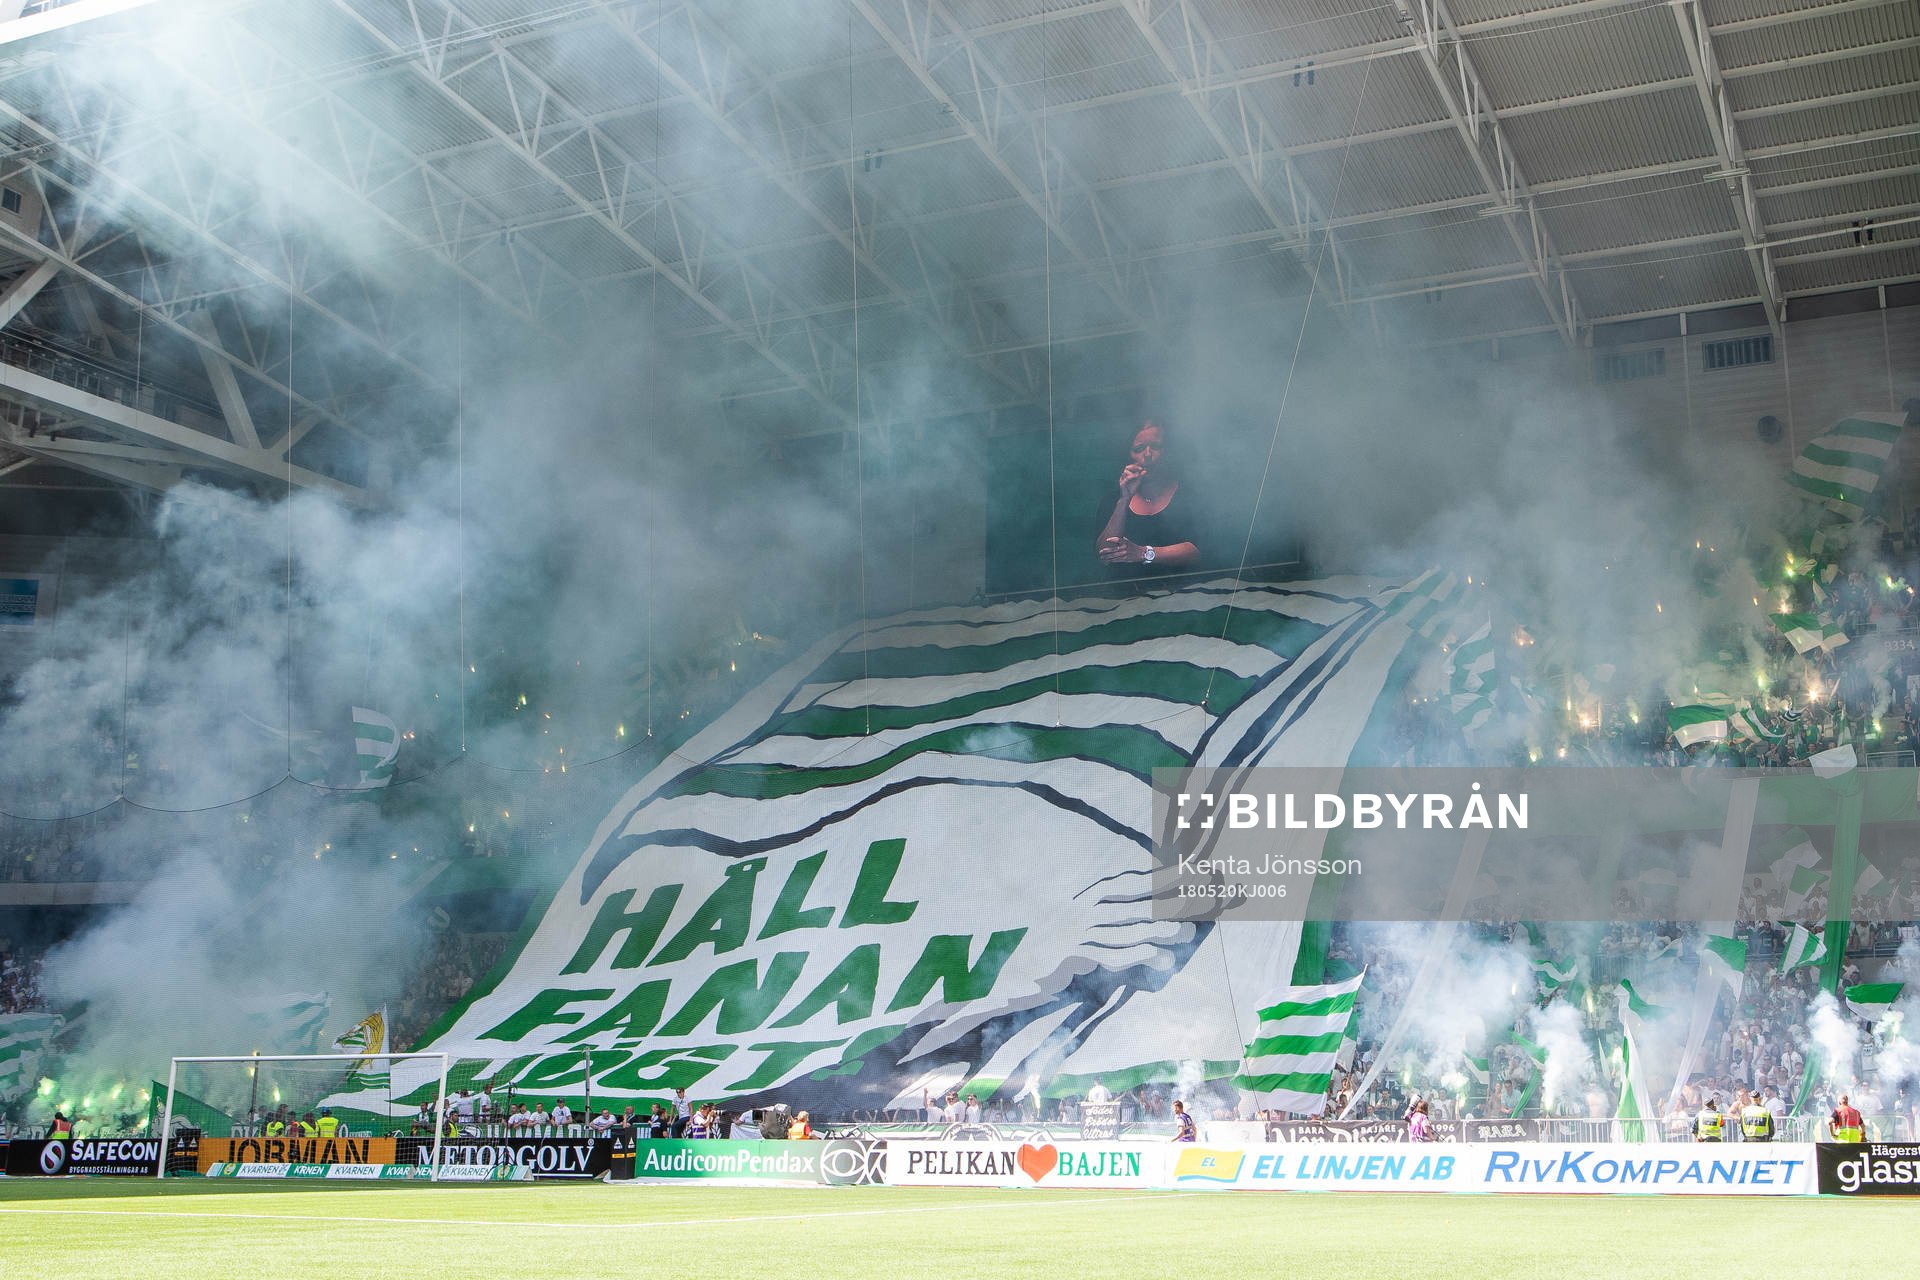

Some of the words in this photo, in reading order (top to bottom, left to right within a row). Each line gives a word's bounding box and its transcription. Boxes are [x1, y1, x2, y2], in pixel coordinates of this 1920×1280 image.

[559, 838, 919, 975] HÅLL
[478, 927, 1028, 1044] FANAN
[1299, 1126, 1324, 1134] BARA
[1432, 1124, 1455, 1132] 1996
[69, 1165, 138, 1174] BYGGNADSSTÄLLNINGAR
[417, 1146, 593, 1171] METODGOLV
[644, 1149, 815, 1173] AudicomPendax
[907, 1151, 1015, 1175] PELIKAN
[1057, 1152, 1142, 1176] BAJEN
[1200, 1157, 1216, 1167] EL
[1252, 1155, 1287, 1179] EL
[1296, 1155, 1405, 1180] LINJEN
[1409, 1156, 1456, 1180] AB
[241, 1166, 277, 1174] KVARNEN
[334, 1167, 376, 1175] KVARNEN
[451, 1167, 490, 1176] KVARNEN
